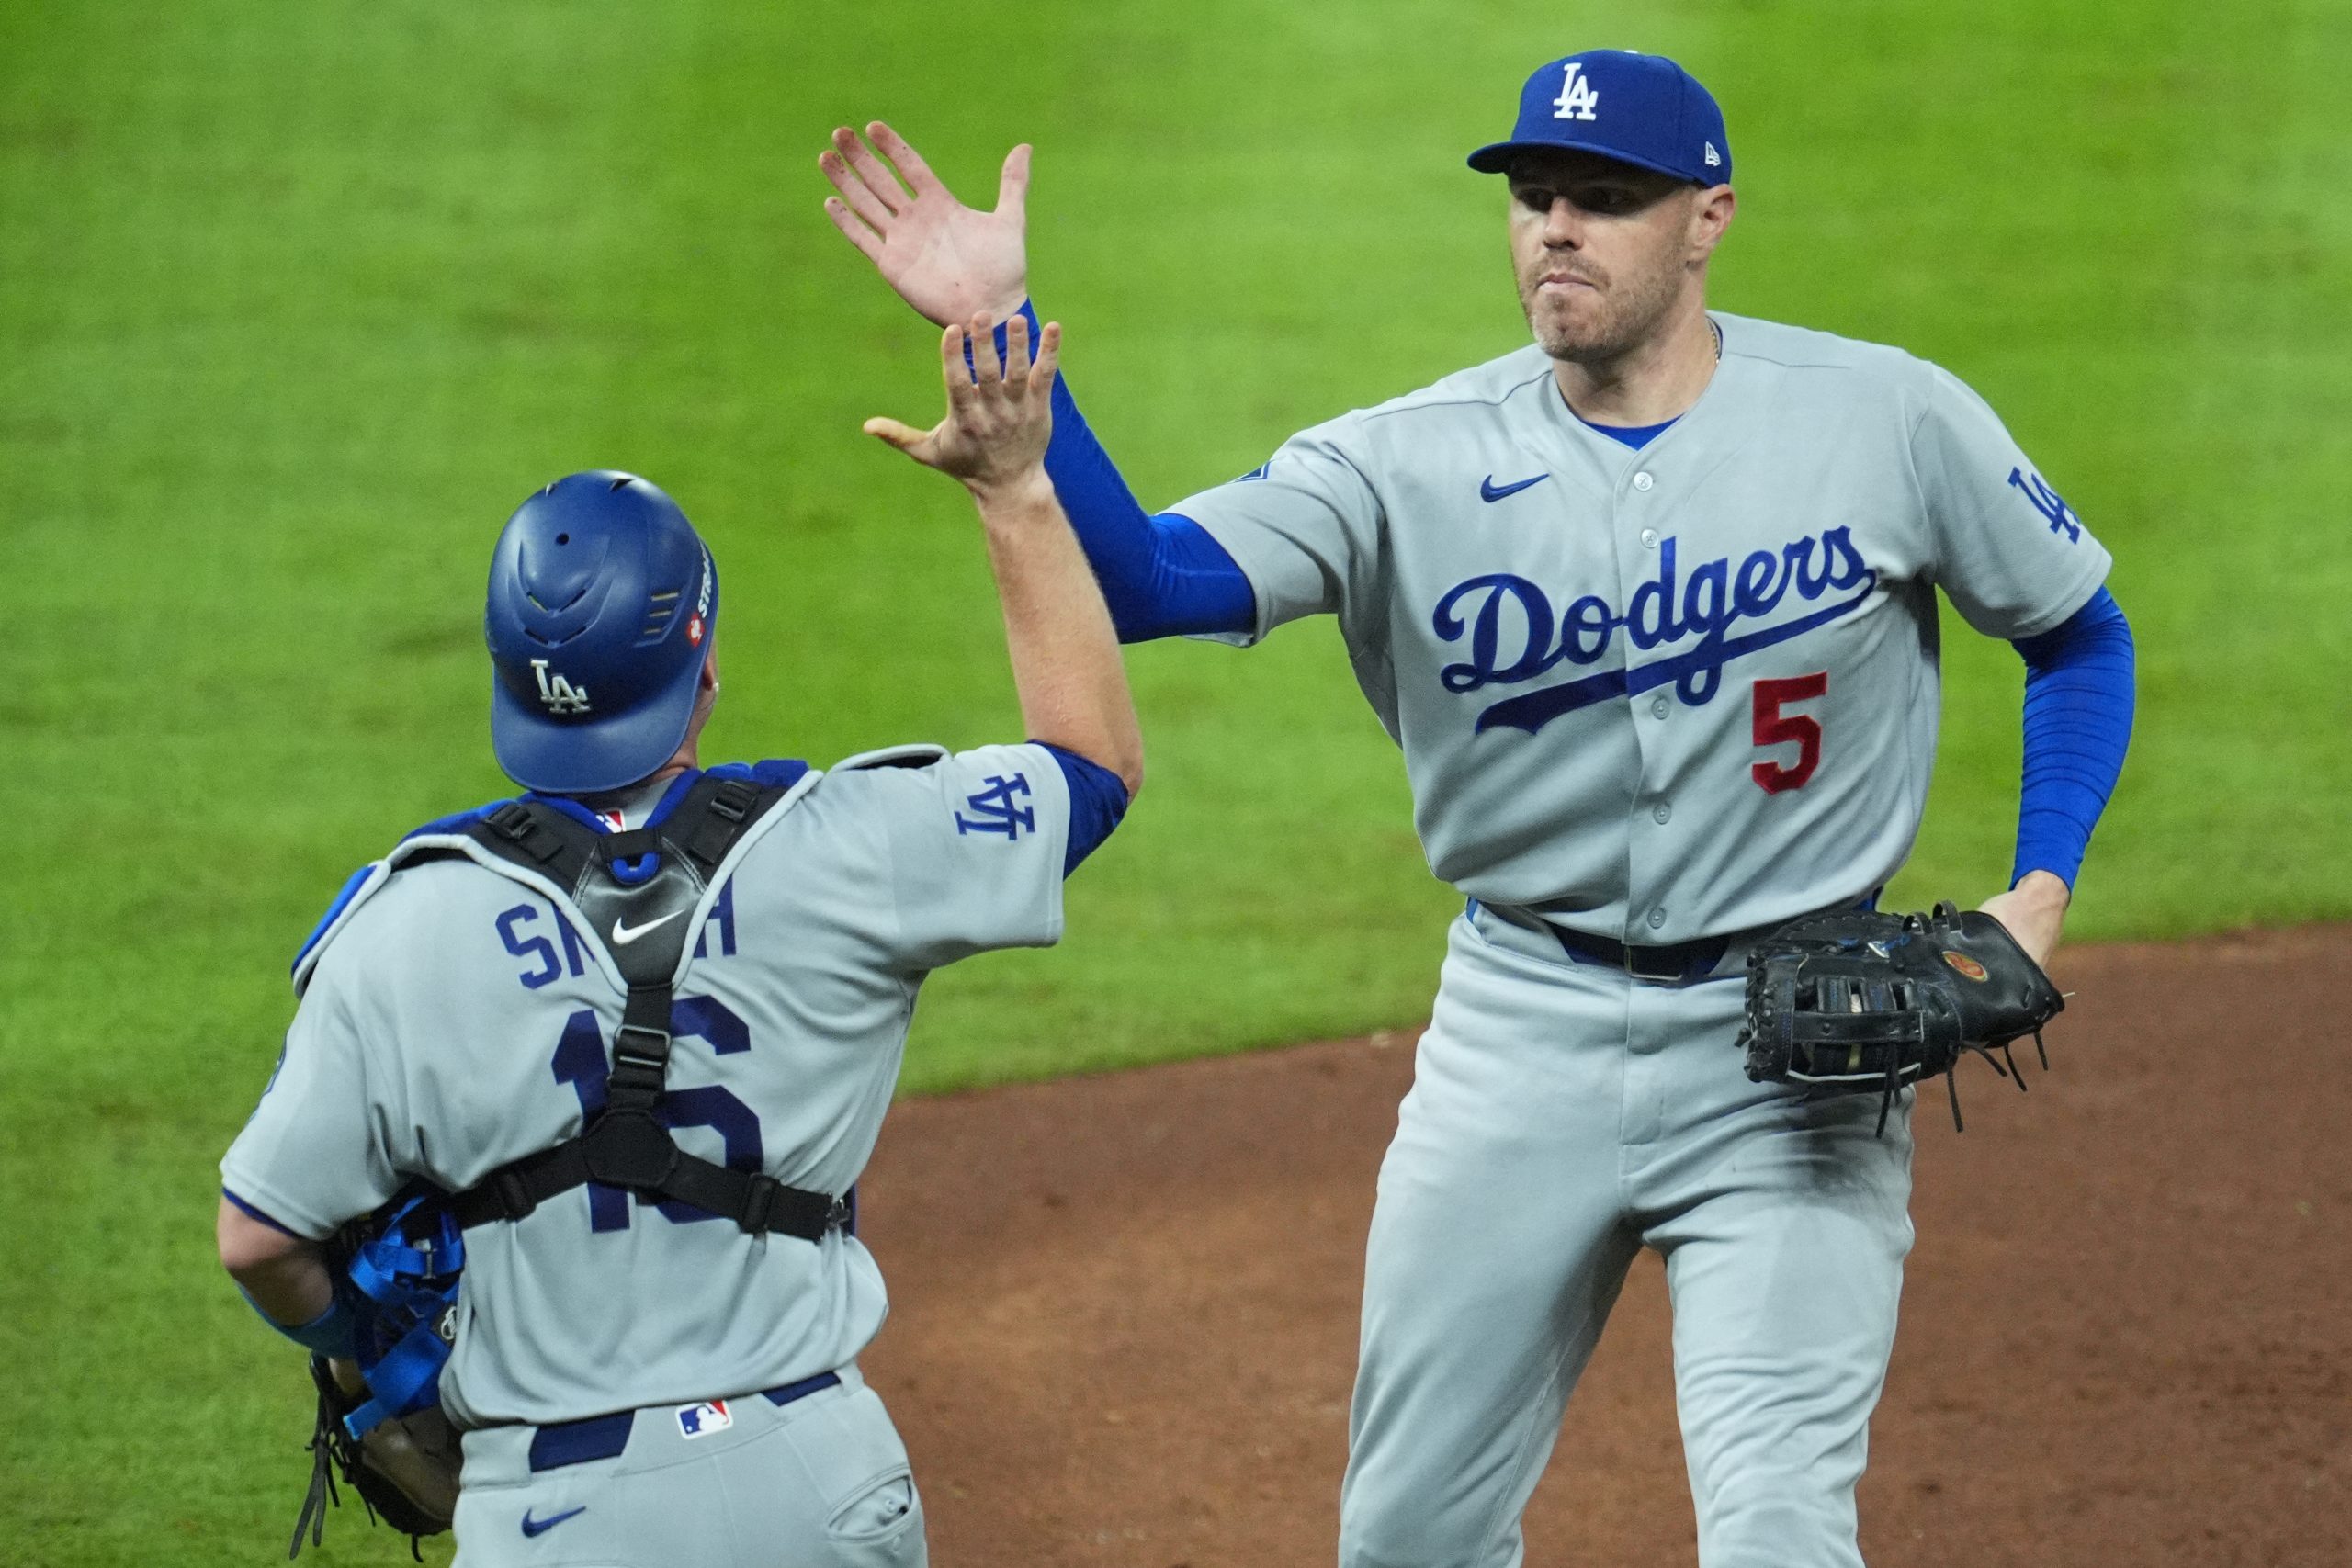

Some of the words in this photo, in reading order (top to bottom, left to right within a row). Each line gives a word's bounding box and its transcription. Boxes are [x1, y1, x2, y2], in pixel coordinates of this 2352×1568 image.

[1553, 62, 1599, 121] LA
[2007, 466, 2081, 545] LA
[1432, 525, 1877, 706] Dodgers
[529, 659, 591, 714] LA
[1751, 671, 1828, 795] 5
[954, 773, 1036, 840] LA
